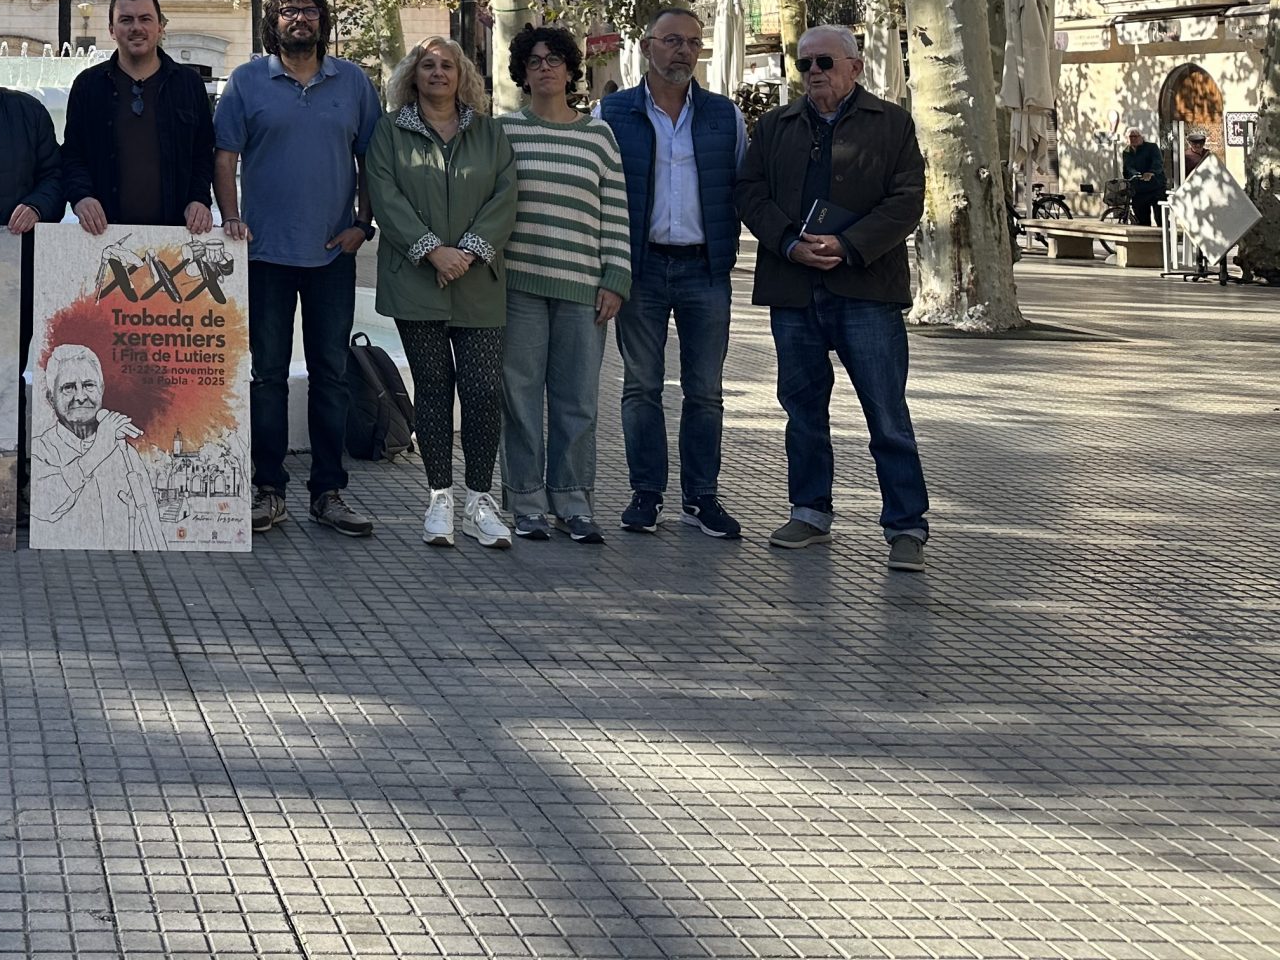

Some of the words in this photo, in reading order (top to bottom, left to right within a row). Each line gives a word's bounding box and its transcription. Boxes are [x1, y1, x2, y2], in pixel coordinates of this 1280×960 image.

[111, 308, 194, 327] Trobada
[200, 309, 225, 328] de
[111, 328, 226, 348] xeremiers
[112, 348, 116, 361] i
[121, 349, 148, 362] Fira
[152, 350, 171, 362] de
[175, 350, 225, 363] Lutiers
[171, 366, 225, 376] novembre
[142, 376, 154, 385] sa
[157, 376, 188, 386] Pobla
[198, 377, 225, 386] 2025
